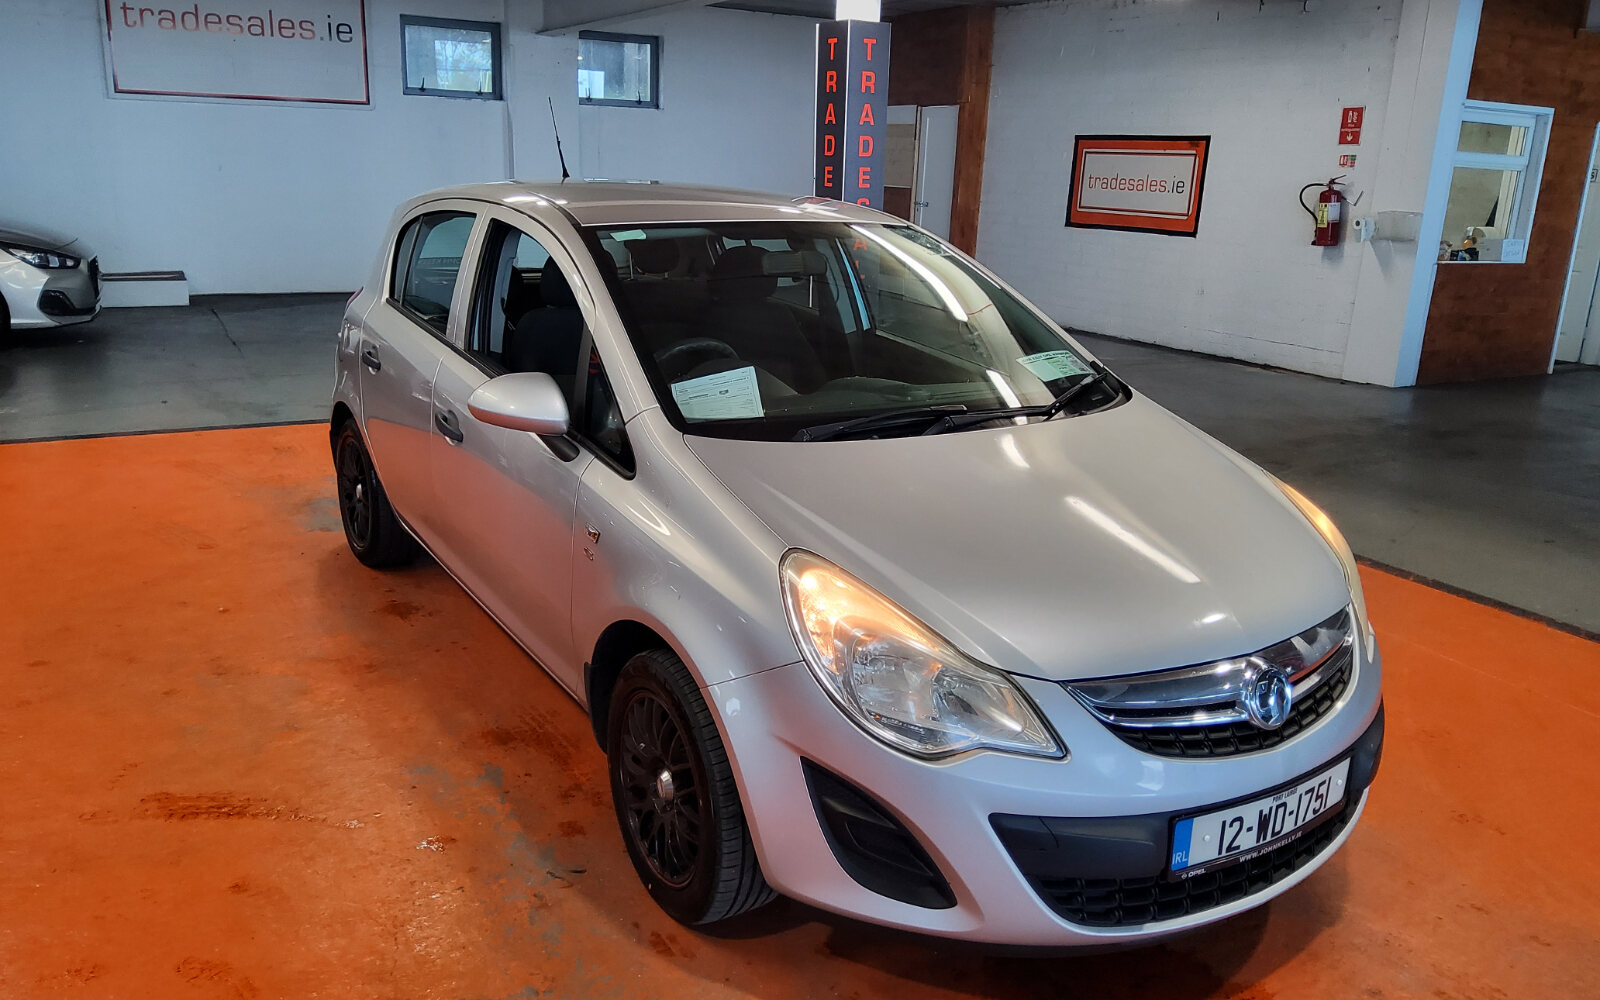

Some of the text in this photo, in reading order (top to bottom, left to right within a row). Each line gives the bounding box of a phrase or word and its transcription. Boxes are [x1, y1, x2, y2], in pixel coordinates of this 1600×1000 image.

[120, 1, 353, 43] tradesales.ie
[824, 37, 838, 200] TRADE
[1088, 173, 1185, 194] tradesales.ie
[1217, 776, 1332, 856] 12-WD-1751
[1172, 850, 1188, 865] IRL
[1188, 868, 1206, 878] OPEL
